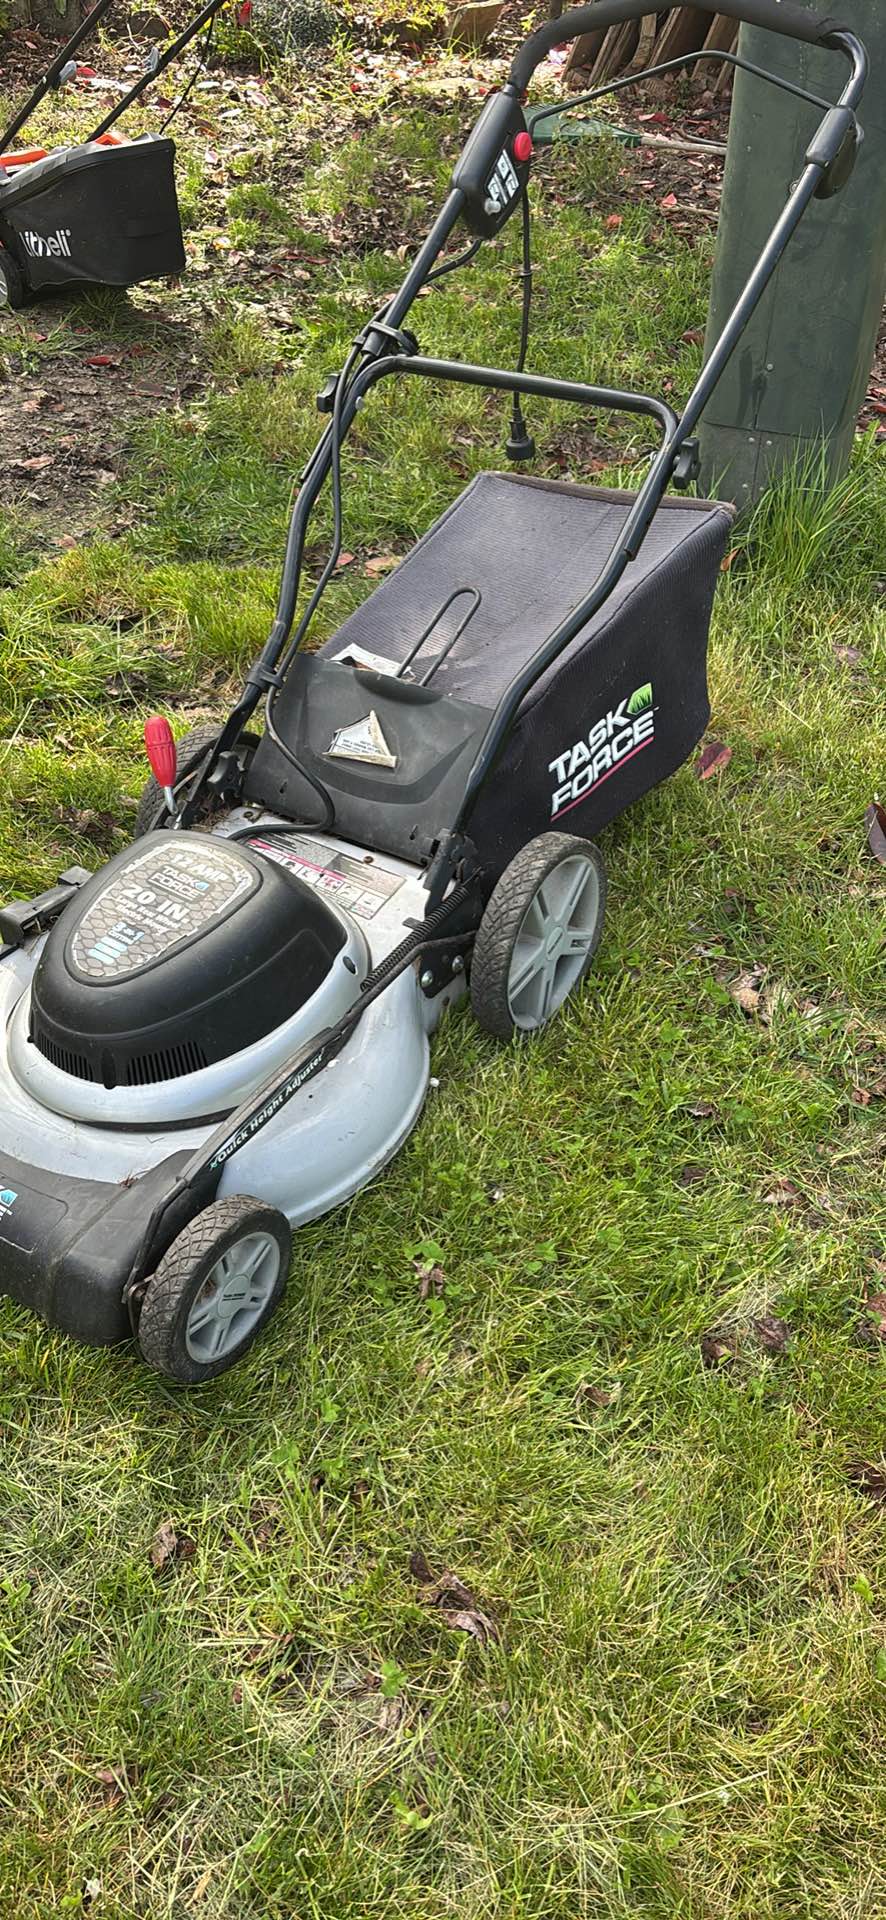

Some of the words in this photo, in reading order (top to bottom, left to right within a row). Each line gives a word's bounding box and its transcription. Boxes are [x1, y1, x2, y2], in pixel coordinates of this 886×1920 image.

[548, 698, 631, 783] TASK
[551, 711, 655, 816] FORCE
[120, 884, 157, 904] 20
[156, 899, 190, 924] IN.
[151, 872, 202, 898] FORCE
[163, 866, 196, 887] TASK
[219, 1131, 249, 1162] Quick
[250, 1095, 284, 1131] Height
[285, 1054, 323, 1097] Adjuster
